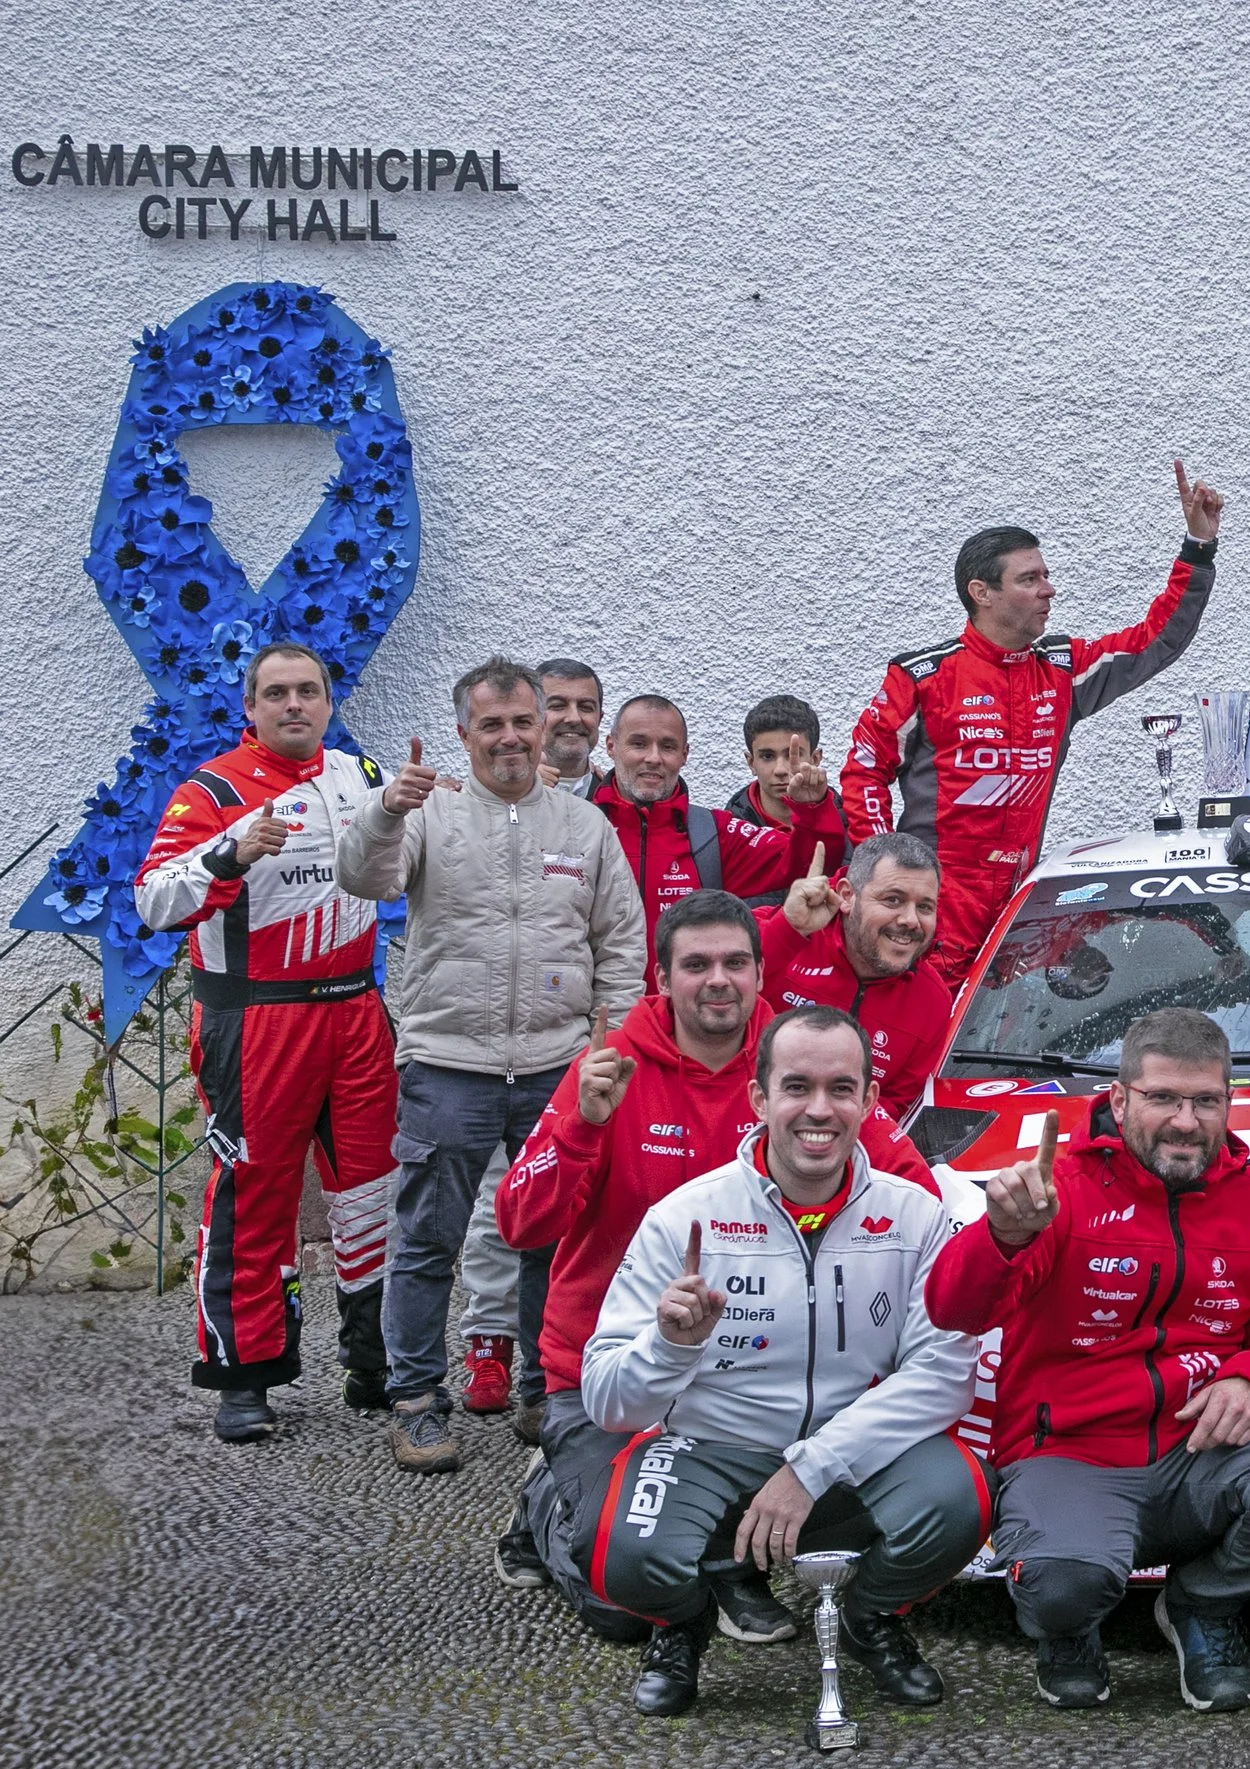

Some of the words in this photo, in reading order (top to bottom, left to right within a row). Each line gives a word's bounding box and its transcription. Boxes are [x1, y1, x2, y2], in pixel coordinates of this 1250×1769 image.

[12, 134, 235, 187] CÂMARA
[250, 146, 519, 192] MUNICIPAL
[138, 195, 252, 240] CITY
[267, 199, 397, 241] HALL
[1048, 654, 1071, 664] OMP
[912, 662, 934, 676] OMP
[959, 712, 1002, 721] CASSIANO'S
[954, 746, 1053, 770] LOTES
[863, 786, 888, 835] LOTE
[1168, 848, 1205, 857] 100
[280, 863, 335, 886] virtu
[662, 873, 690, 881] SKODA
[658, 887, 693, 896] LOTES
[870, 1047, 891, 1062] ODA
[650, 1123, 676, 1136] elf
[641, 1143, 695, 1157] CASSIANOS
[710, 1219, 768, 1236] PAMESA
[851, 1231, 902, 1243] MVASCONCELO
[1088, 1257, 1120, 1274] elf
[726, 1275, 766, 1296] OLI
[1083, 1286, 1137, 1301] virtualcar
[1194, 1298, 1240, 1310] LOTES
[717, 1335, 750, 1349] elf
